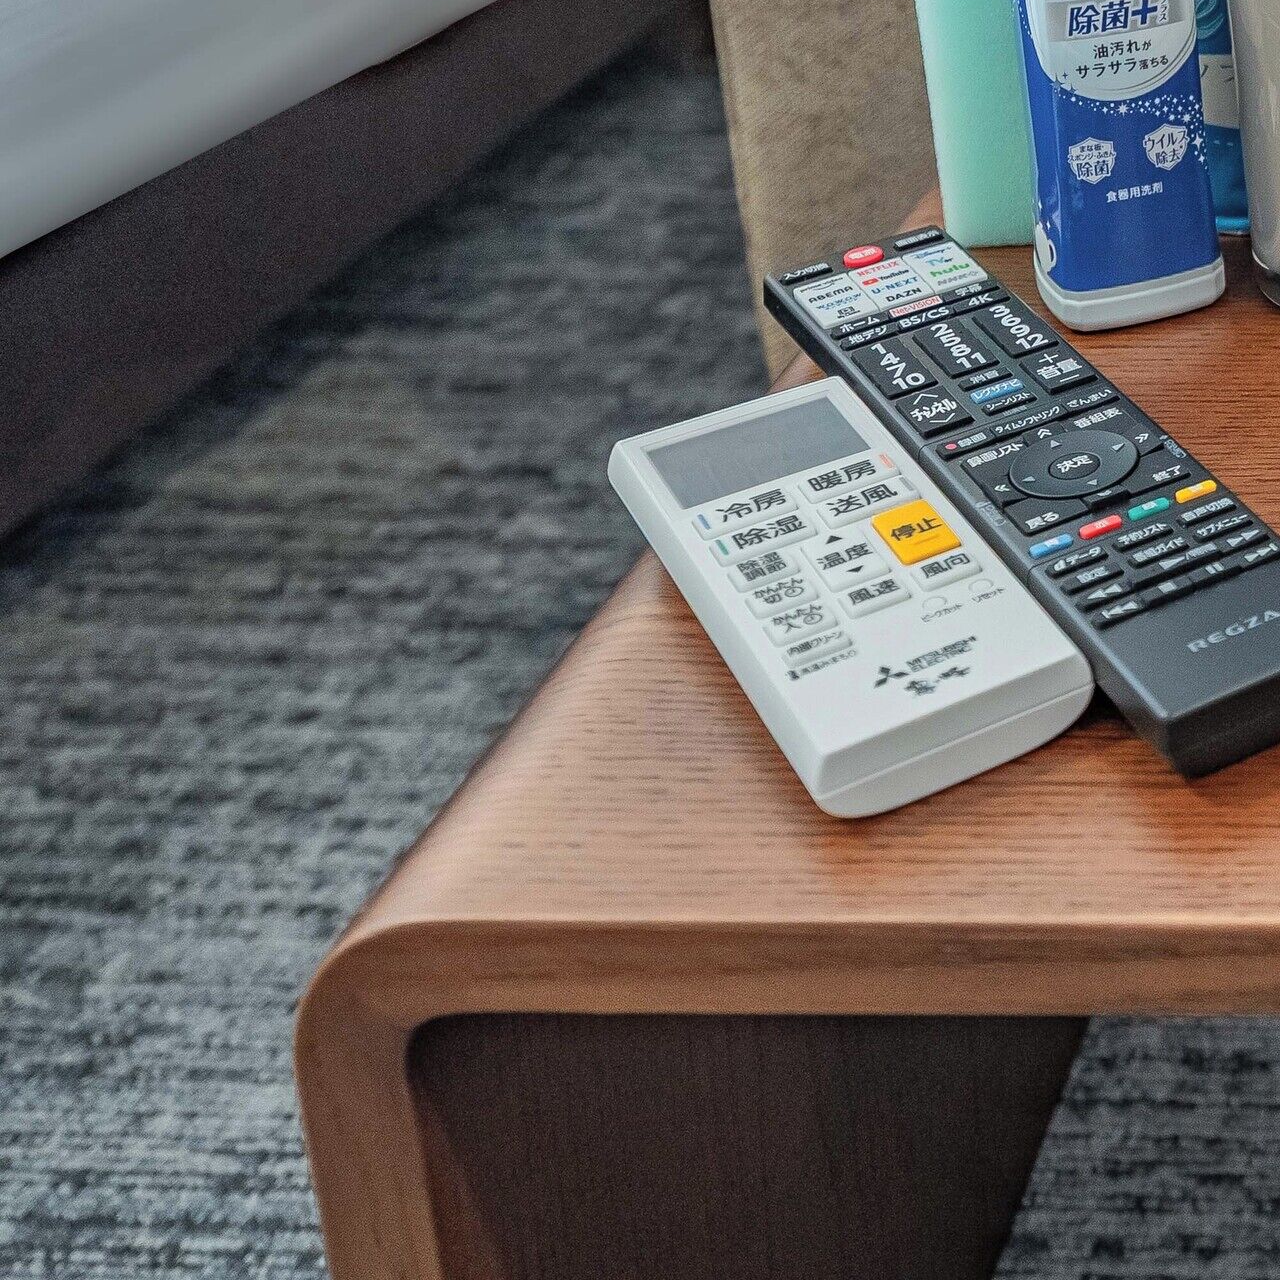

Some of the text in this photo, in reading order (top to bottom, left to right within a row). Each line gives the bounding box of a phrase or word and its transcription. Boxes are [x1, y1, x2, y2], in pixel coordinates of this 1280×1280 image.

[1093, 39, 1152, 60] 油汚れが
[1076, 55, 1169, 79] サラサラ落ちる
[1146, 130, 1189, 152] ウイルス
[1155, 148, 1181, 166] 除去
[1077, 161, 1110, 178] 除菌
[1106, 181, 1163, 202] 食器用洗剤
[929, 263, 970, 277] hulu
[808, 286, 853, 303] ABEMA
[871, 277, 918, 294] U-NEXT
[886, 288, 922, 302] DAZN
[969, 293, 994, 306] 4K
[899, 307, 950, 328] BS/CS
[989, 305, 1007, 317] 3
[839, 317, 880, 333] ホーム
[1001, 315, 1020, 327] 6
[848, 325, 888, 345] 地デジ
[930, 324, 947, 338] 2
[1010, 325, 1031, 338] 9
[871, 344, 886, 355] 1
[941, 335, 957, 347] 5
[1015, 333, 1049, 351] 12
[880, 352, 899, 364] 4
[951, 345, 972, 357] 8
[957, 352, 987, 369] 11
[1036, 358, 1083, 380] 音量
[887, 363, 907, 377] 7
[892, 373, 926, 390] 10
[986, 392, 1031, 411] シーンリスト
[1057, 455, 1093, 473] 決定
[1152, 465, 1181, 481] 終了
[807, 460, 877, 492] 暖房
[716, 488, 788, 523] 冷房
[828, 484, 899, 517] 送風
[891, 518, 942, 542] 停止
[1025, 512, 1059, 530] 戻る
[732, 515, 807, 550] 除湿
[736, 552, 781, 572] 除湿
[816, 542, 874, 570] 温度
[921, 554, 971, 578] 風向
[754, 577, 804, 599] かんたん
[848, 578, 900, 605] 風速
[772, 604, 823, 625] かんたん
[785, 621, 802, 633] 入
